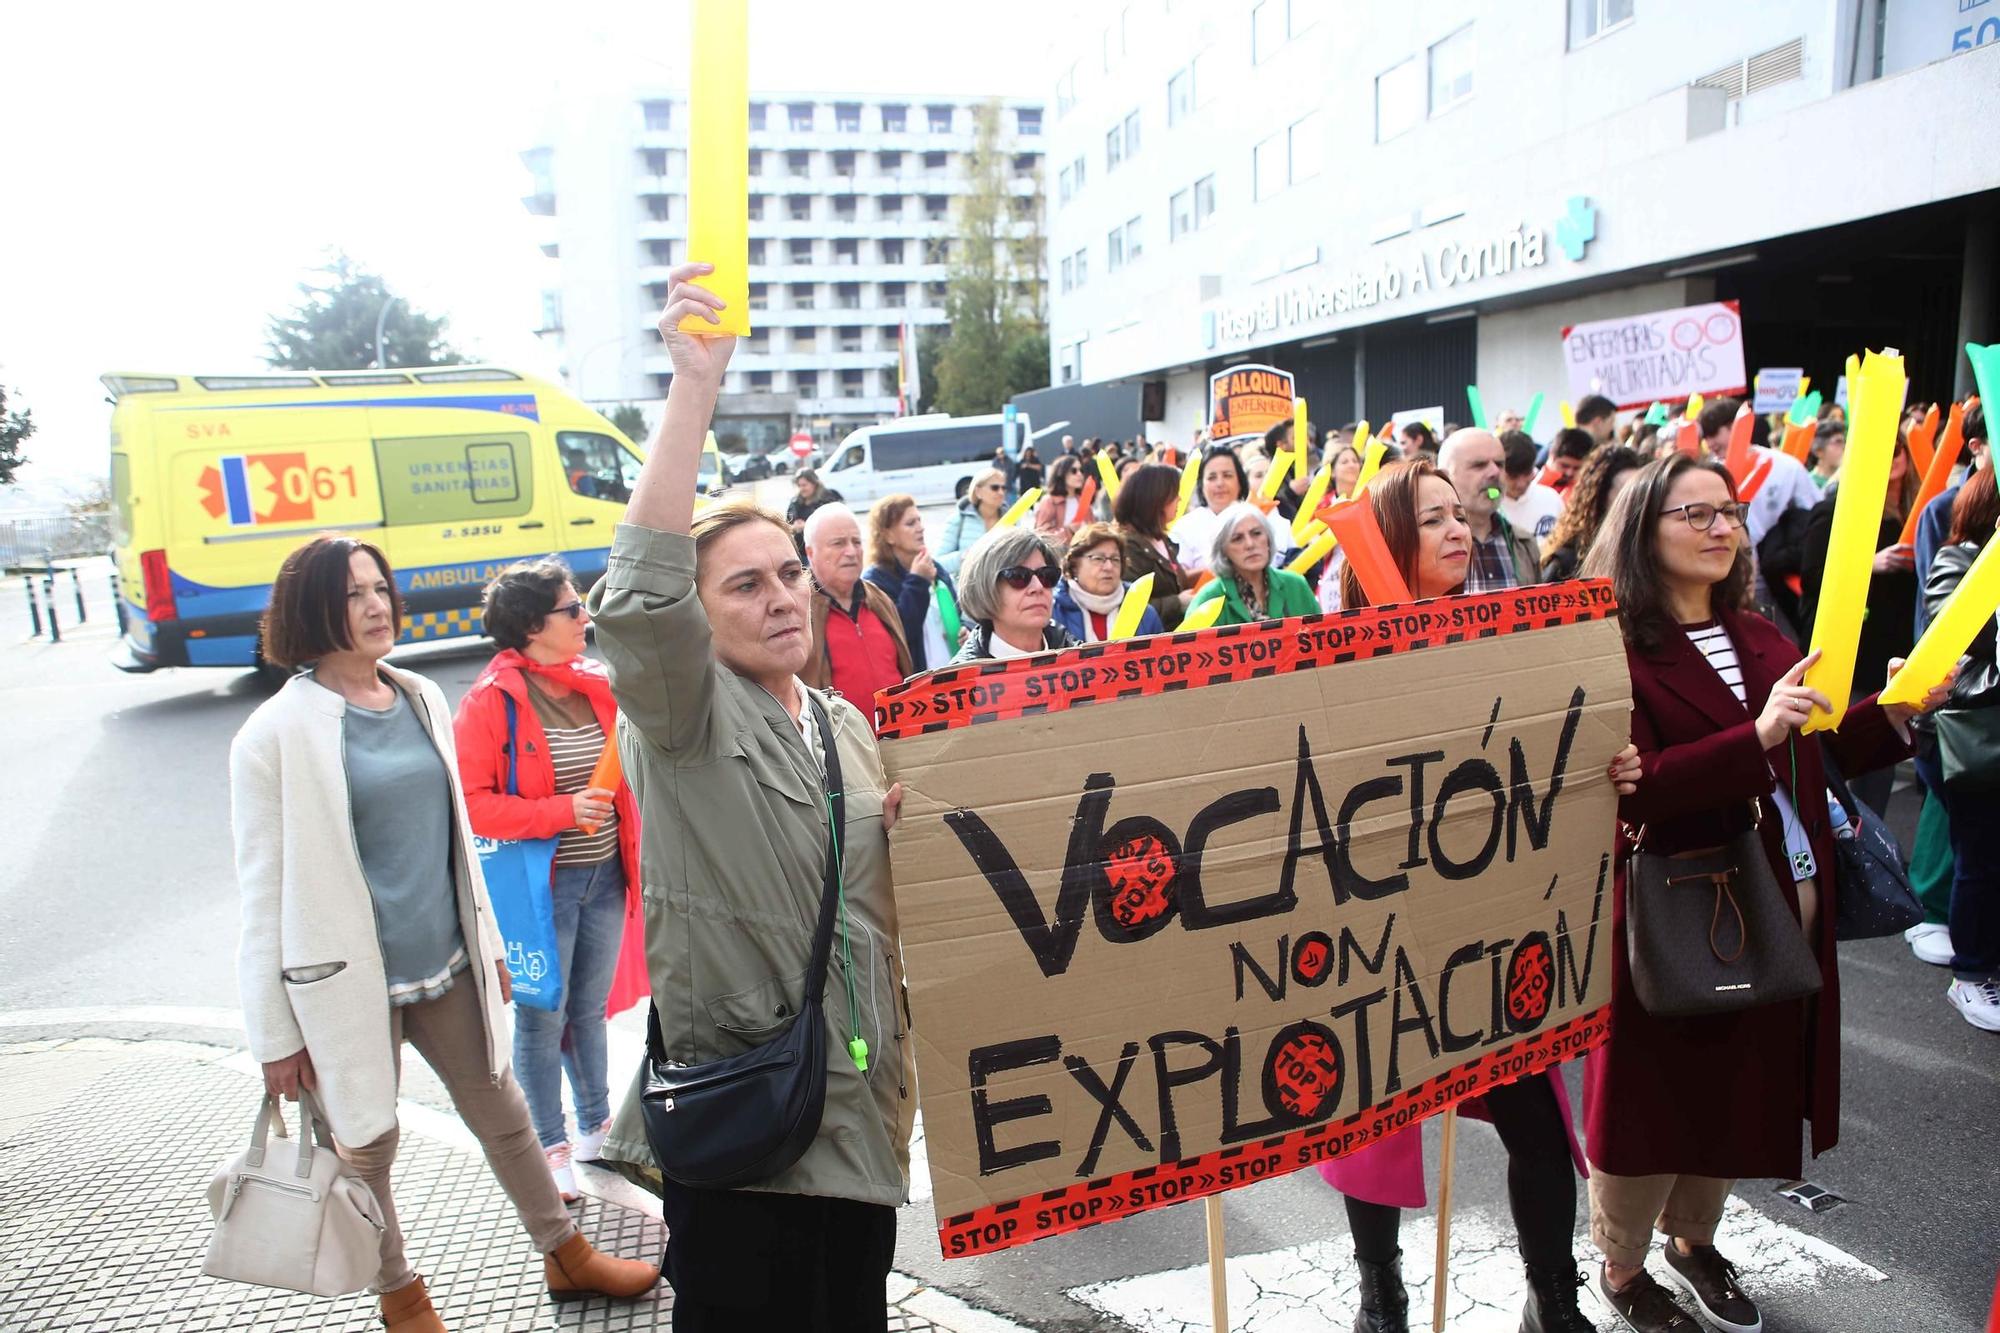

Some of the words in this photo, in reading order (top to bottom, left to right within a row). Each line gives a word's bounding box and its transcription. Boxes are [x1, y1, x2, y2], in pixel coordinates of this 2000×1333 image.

[1281, 258, 1401, 326] Universitario
[1408, 250, 1433, 295] A
[1438, 223, 1545, 288] Coruña
[1231, 371, 1291, 400] ALQUILA
[186, 423, 231, 439] SVA
[409, 458, 509, 476] URXENCIAS
[283, 465, 357, 505] 061
[411, 476, 511, 494] SANITARIAS
[933, 682, 1006, 714] STOP
[1025, 667, 1096, 698] STOP
[1124, 652, 1192, 681] STOP
[1218, 638, 1282, 668] STOP
[1298, 625, 1356, 654] STOP
[1377, 612, 1431, 640] STOP
[1452, 602, 1501, 627] STOP
[1515, 594, 1561, 617] STOP
[943, 685, 1586, 978] VOCACIÓN
[1228, 913, 1396, 1002] NON
[969, 852, 1609, 1177] EXPLOTACIÓN
[950, 1218, 1017, 1255] STOP
[1036, 1198, 1103, 1230] STOP
[1129, 1175, 1194, 1207] STOP
[1220, 1154, 1282, 1185] STOP
[1299, 1130, 1354, 1163] STOP
[1373, 1106, 1418, 1138] STOP
[1434, 1075, 1478, 1107] STOP
[1490, 1051, 1534, 1082] STOP
[1552, 1027, 1593, 1056] STOP
